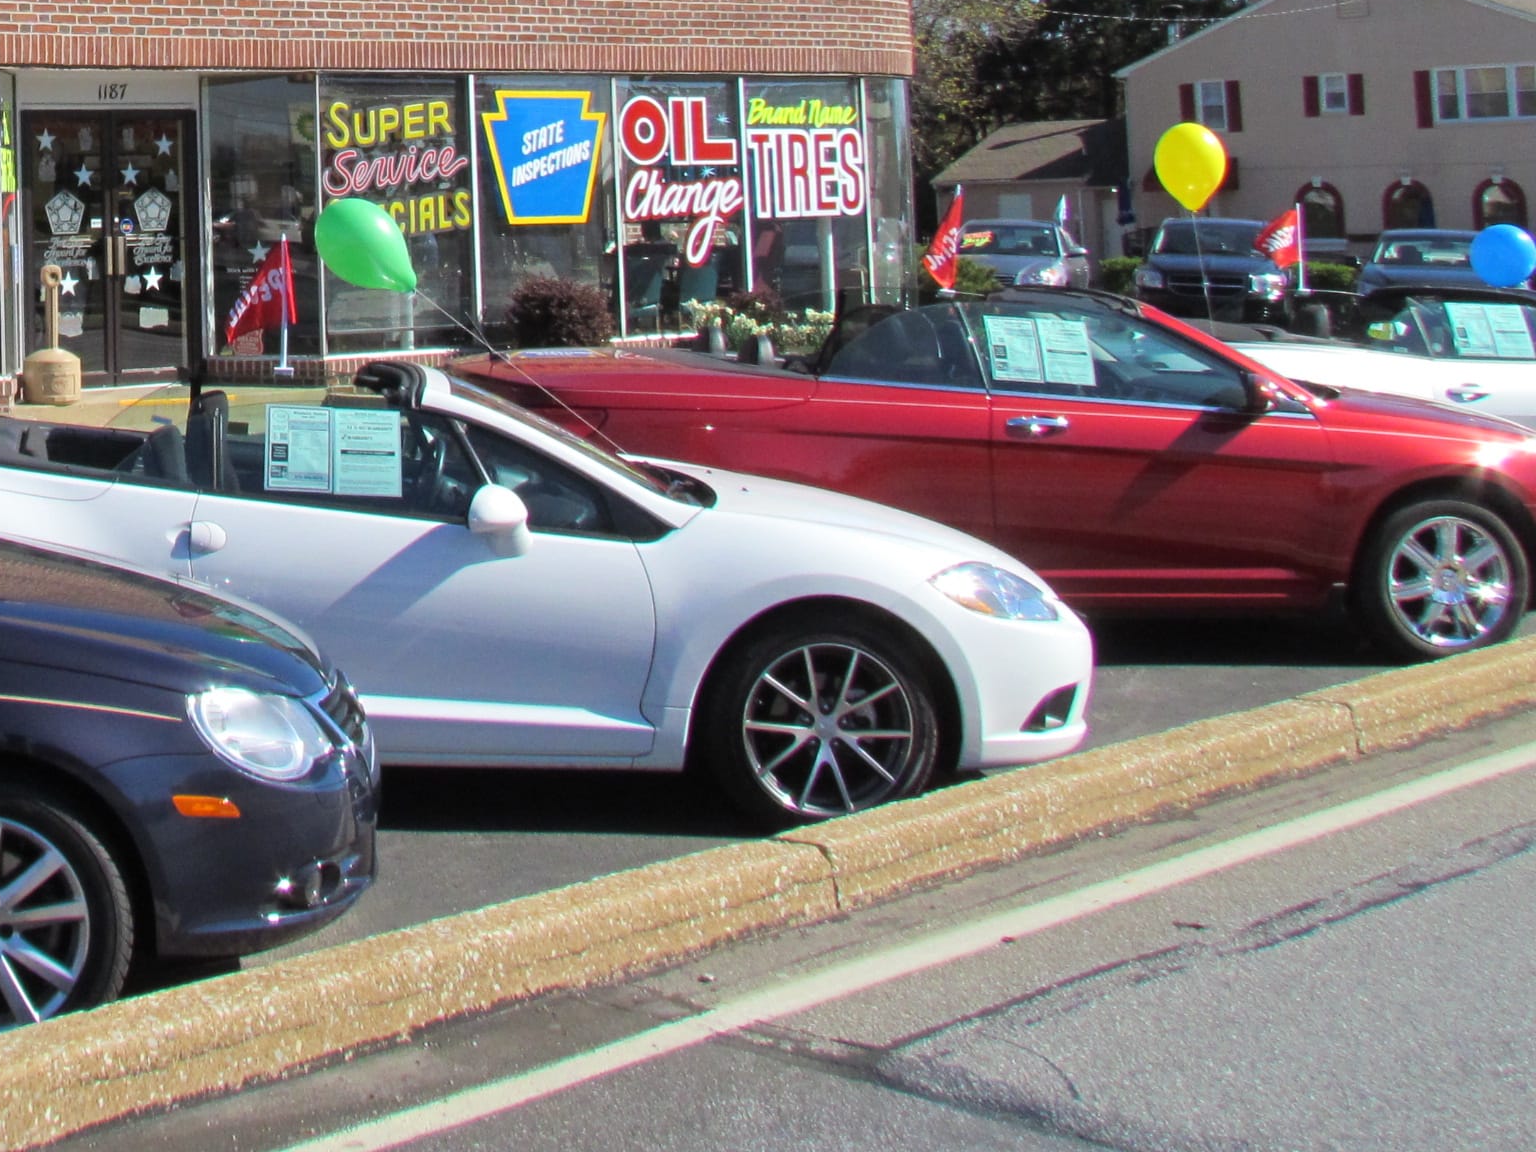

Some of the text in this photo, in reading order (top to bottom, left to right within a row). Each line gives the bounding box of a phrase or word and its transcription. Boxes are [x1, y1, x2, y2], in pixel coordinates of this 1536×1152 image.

[98, 83, 128, 101] 1187
[748, 98, 858, 126] Brand Name
[327, 101, 453, 148] SUPER
[521, 119, 565, 155] STATE
[618, 95, 738, 166] OIL
[323, 145, 469, 196] Service
[511, 141, 591, 188] INSPECTIONS
[748, 127, 865, 219] TIRES
[624, 165, 745, 267] Change
